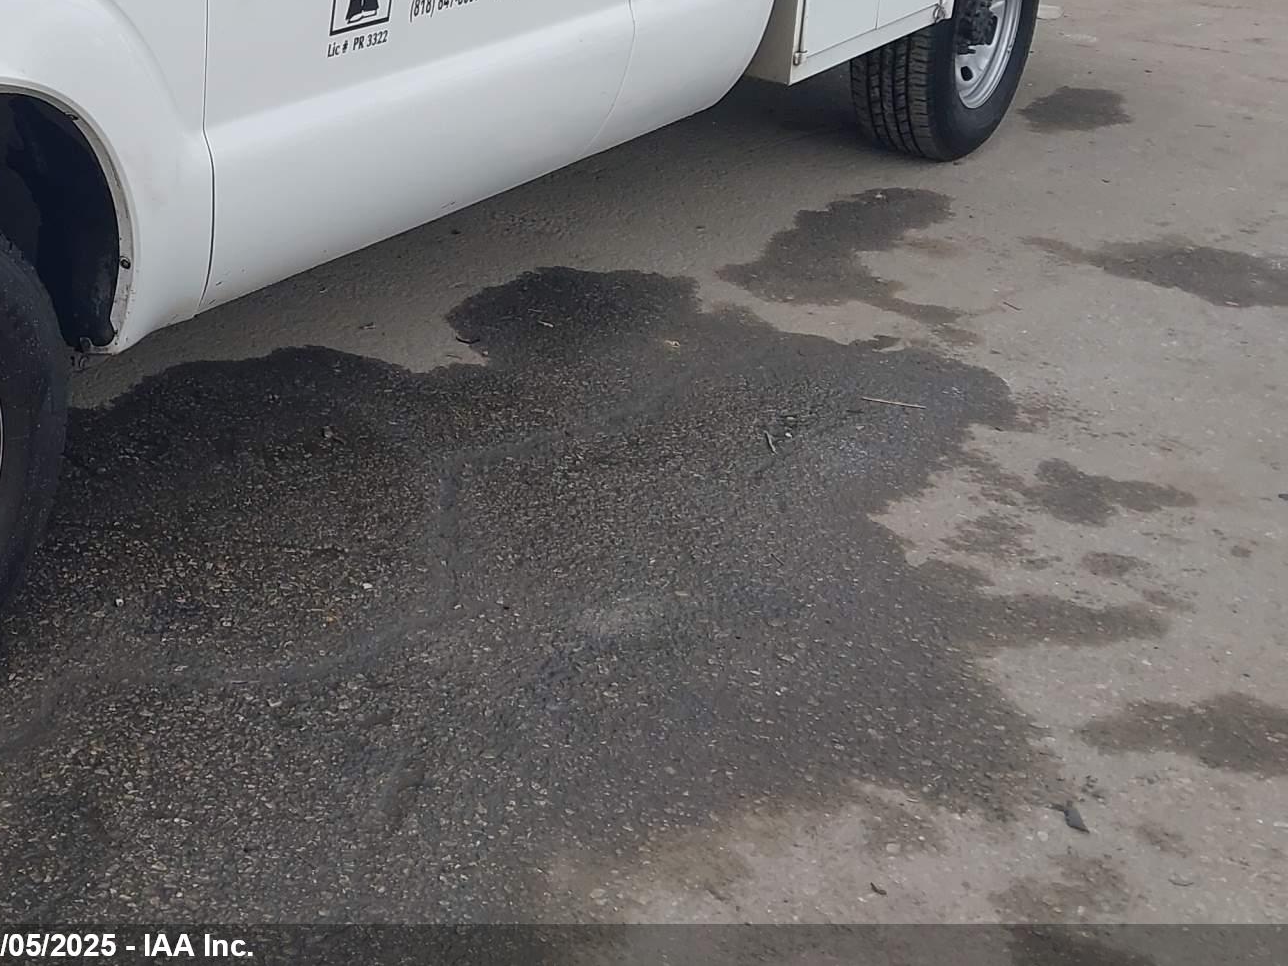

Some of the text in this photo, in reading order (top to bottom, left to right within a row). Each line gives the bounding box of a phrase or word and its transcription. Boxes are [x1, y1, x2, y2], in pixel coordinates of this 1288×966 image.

[327, 30, 389, 58] Lic # PR 3322
